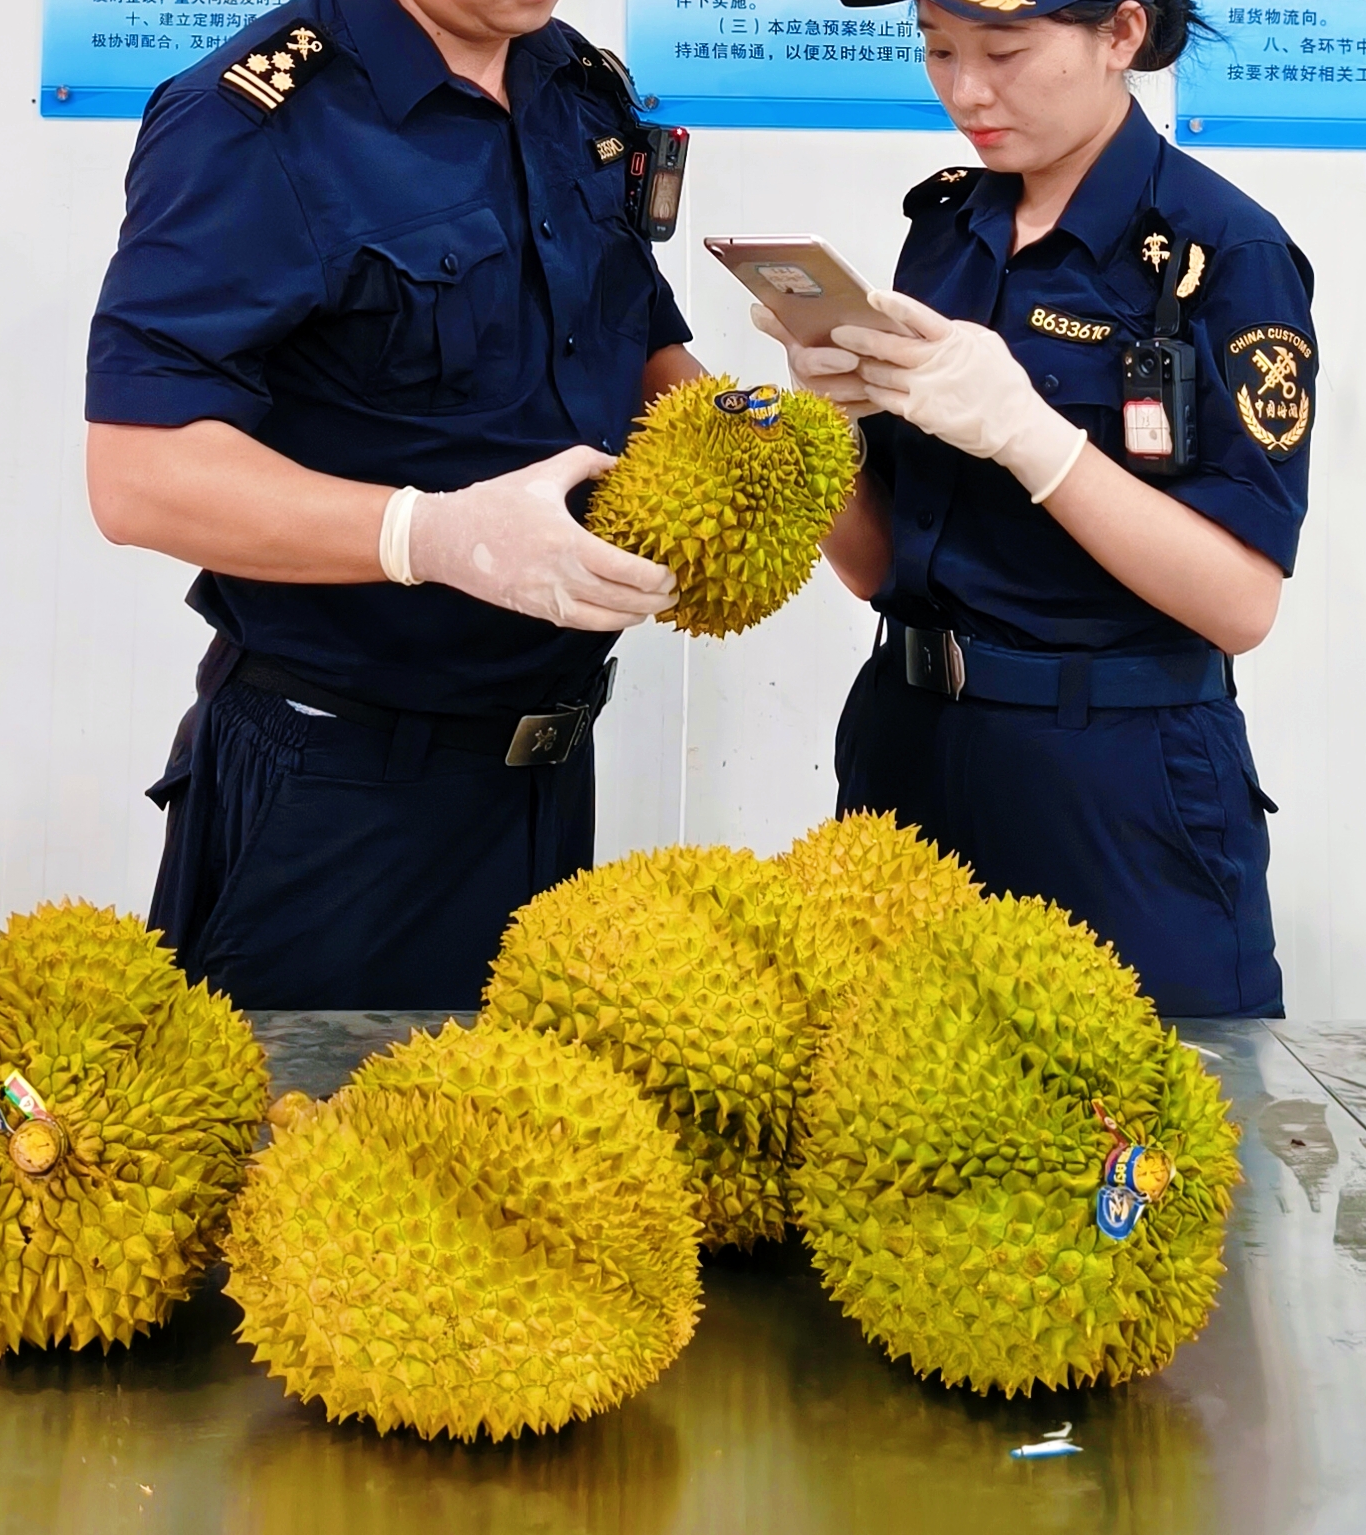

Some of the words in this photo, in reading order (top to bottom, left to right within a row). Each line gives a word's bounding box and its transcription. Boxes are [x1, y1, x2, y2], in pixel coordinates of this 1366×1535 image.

[1228, 7, 1326, 26] 握货物流向。
[91, 33, 227, 55] 极协调配合，及时
[1229, 329, 1265, 354] CHINA
[1267, 327, 1312, 359] CUSTOMS
